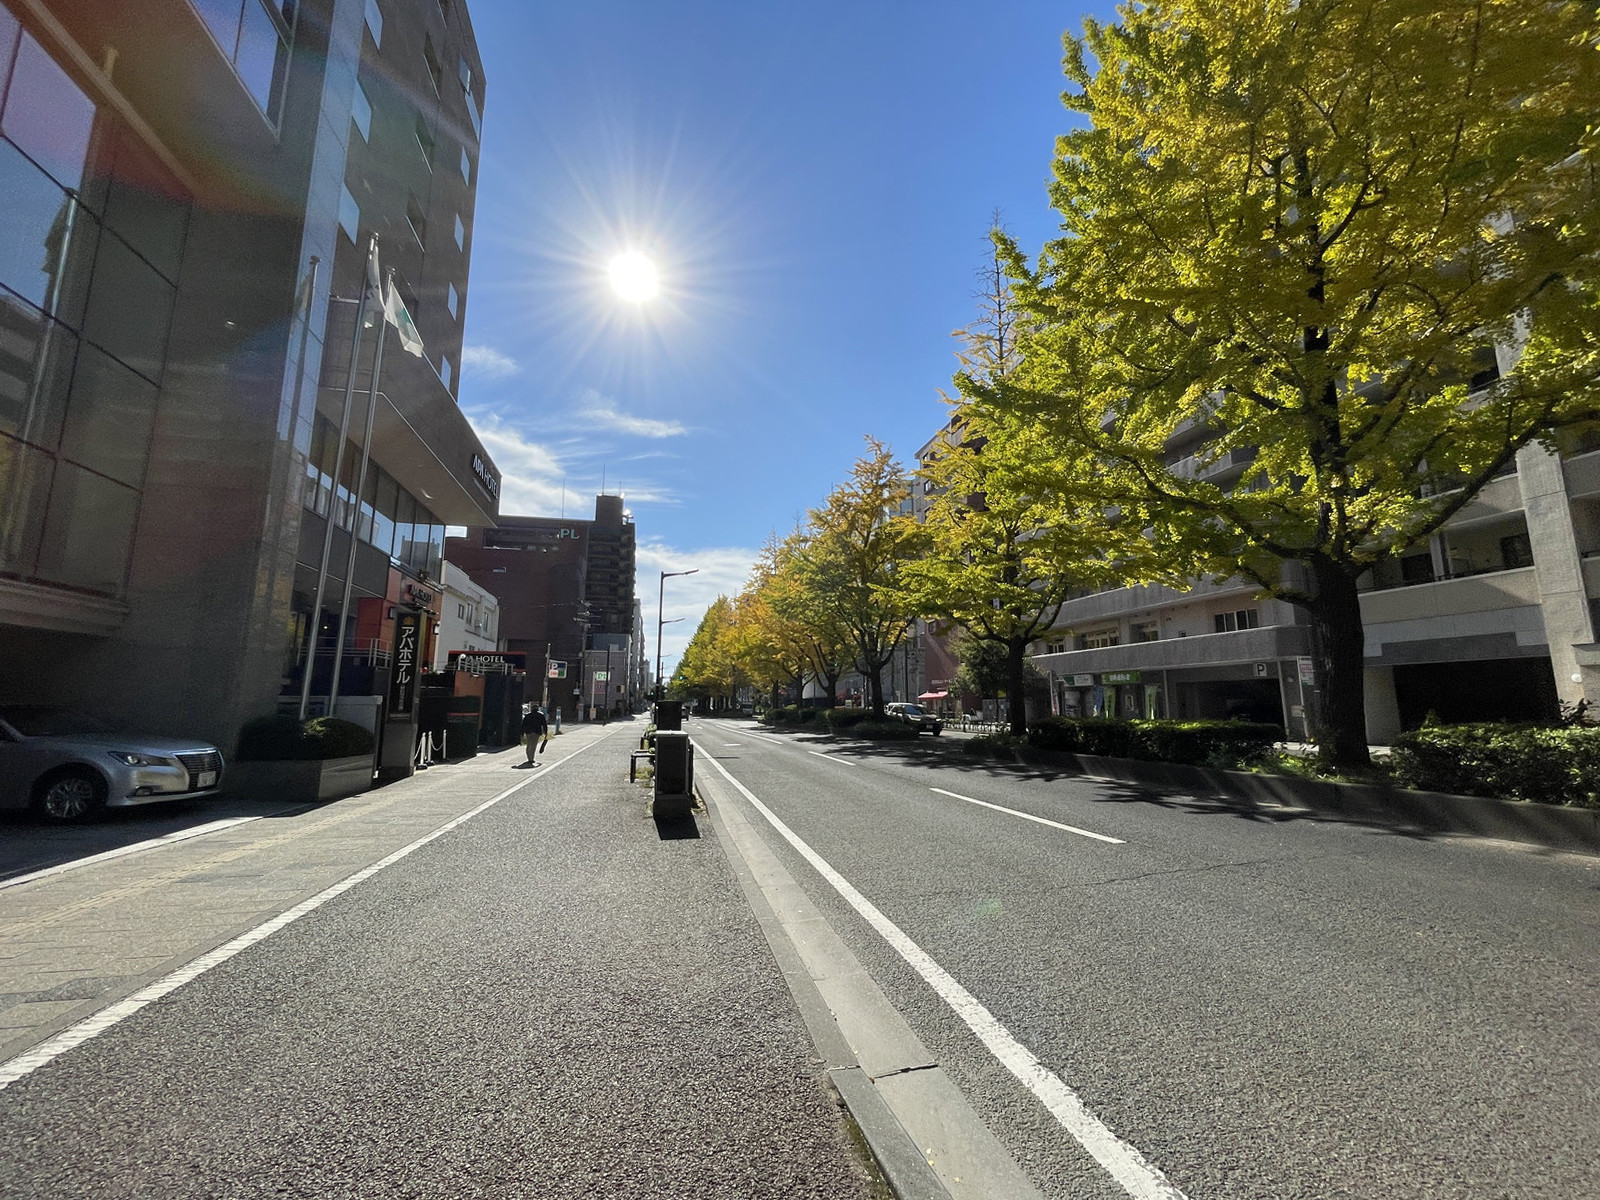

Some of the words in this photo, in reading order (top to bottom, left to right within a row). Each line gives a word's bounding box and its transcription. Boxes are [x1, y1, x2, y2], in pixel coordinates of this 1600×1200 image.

[484, 468, 499, 500] HOTEL
[396, 626, 415, 684] アパホテル
[475, 655, 505, 663] HOTEL
[1256, 663, 1266, 676] P
